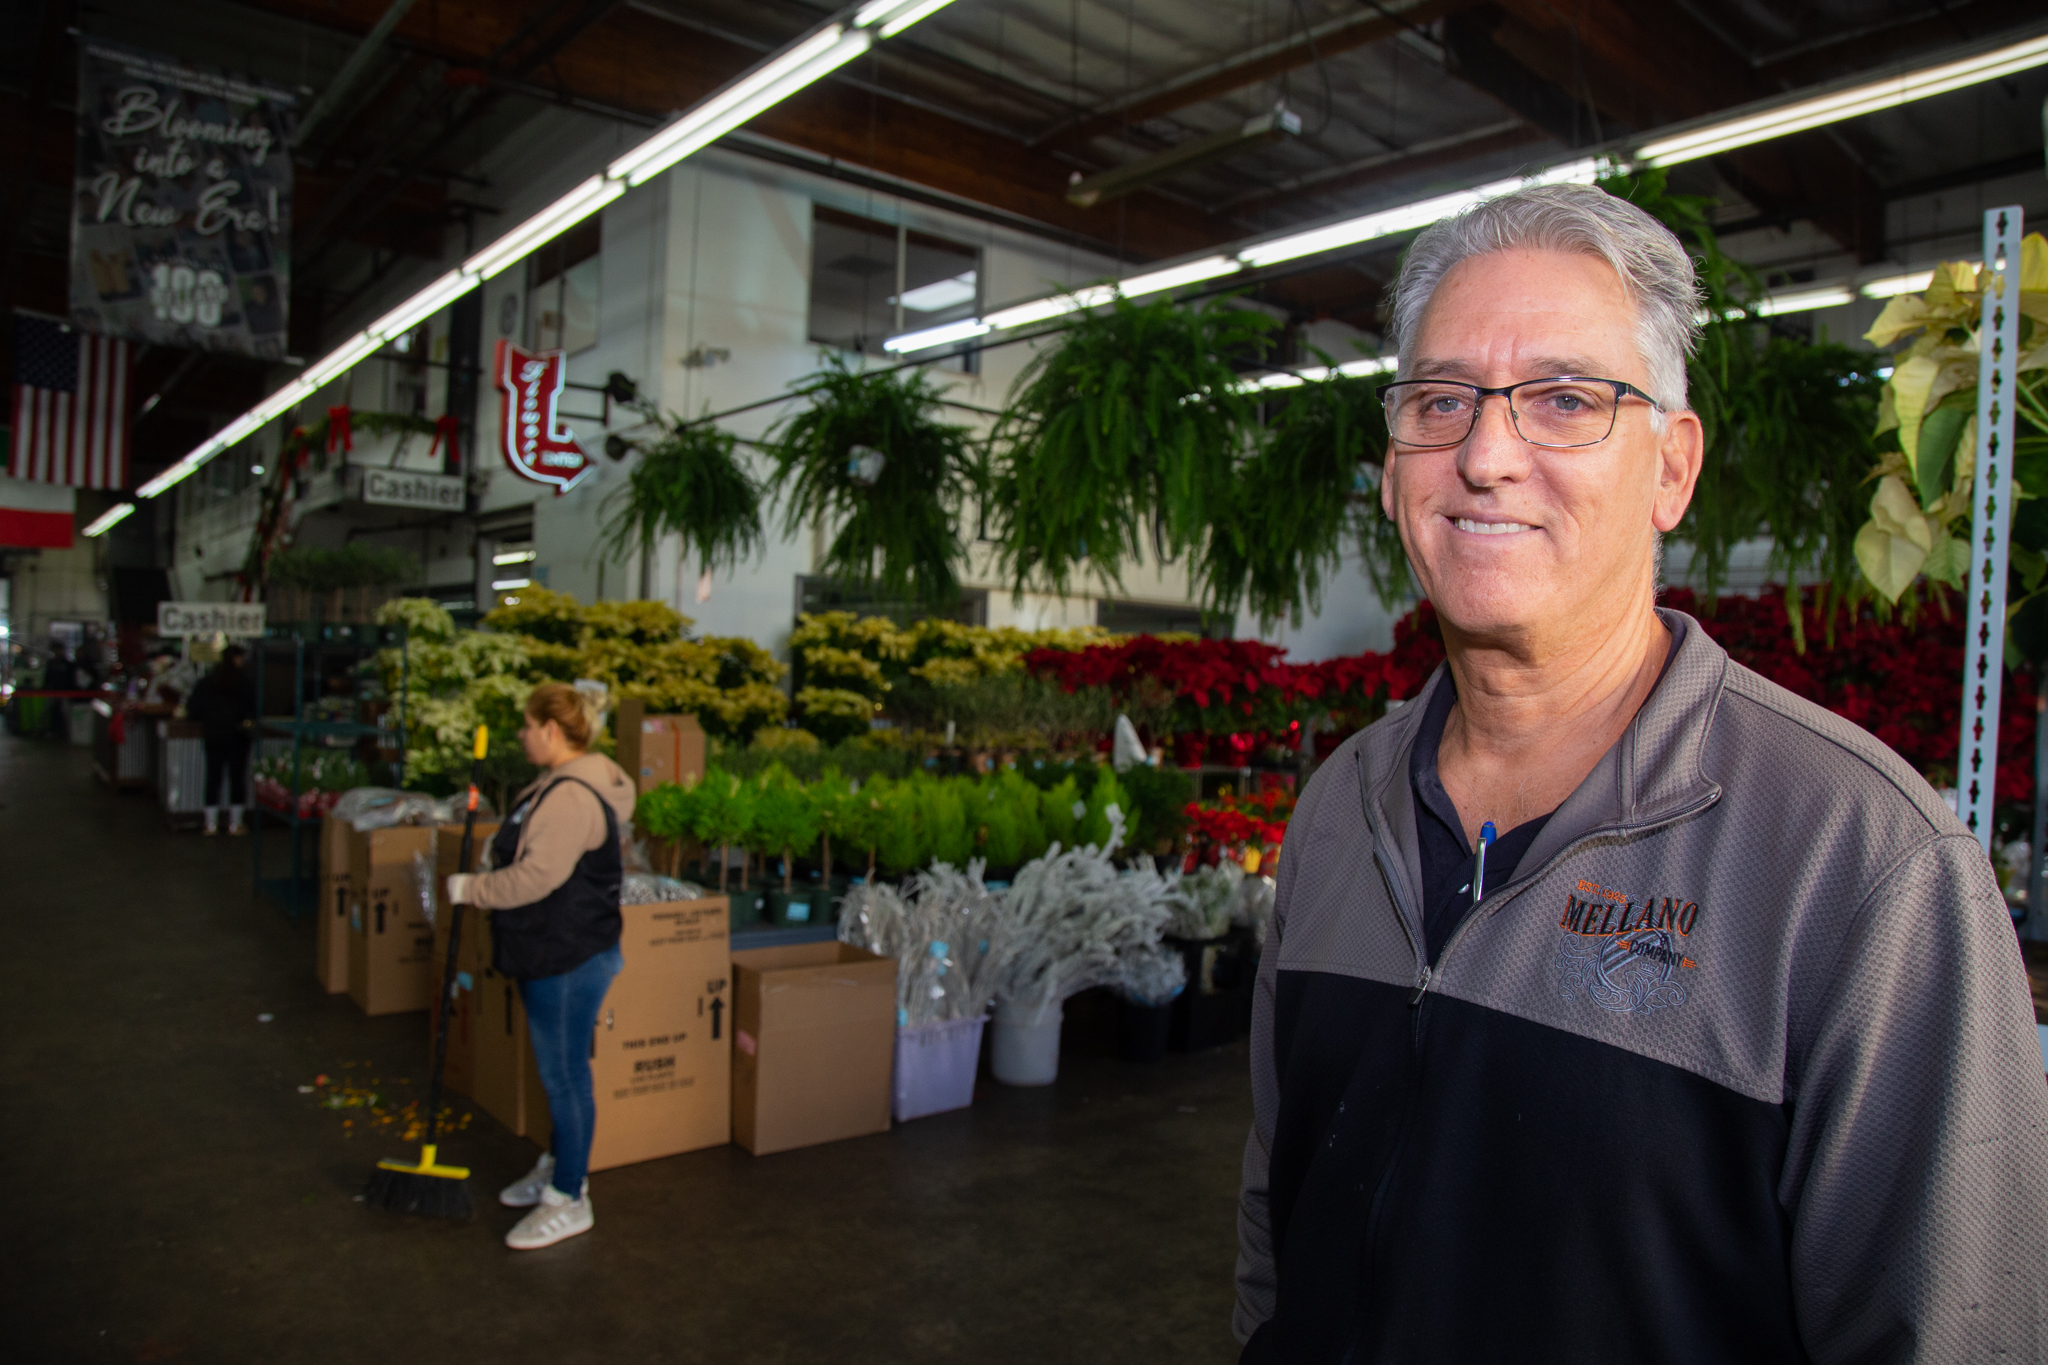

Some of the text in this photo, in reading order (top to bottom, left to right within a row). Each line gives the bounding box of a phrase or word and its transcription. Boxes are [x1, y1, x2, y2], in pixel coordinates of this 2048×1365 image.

[103, 86, 274, 166] Blooming
[134, 138, 194, 177] into
[94, 171, 280, 235] New Era!
[368, 473, 463, 504] Cashier
[162, 606, 262, 633] Cashier
[1577, 879, 1627, 904] EST. 1925
[1559, 893, 1699, 937] MELLANO
[1629, 940, 1684, 968] COMPANY
[706, 980, 726, 994] UP
[648, 1036, 670, 1047] END
[672, 1032, 687, 1043] UP
